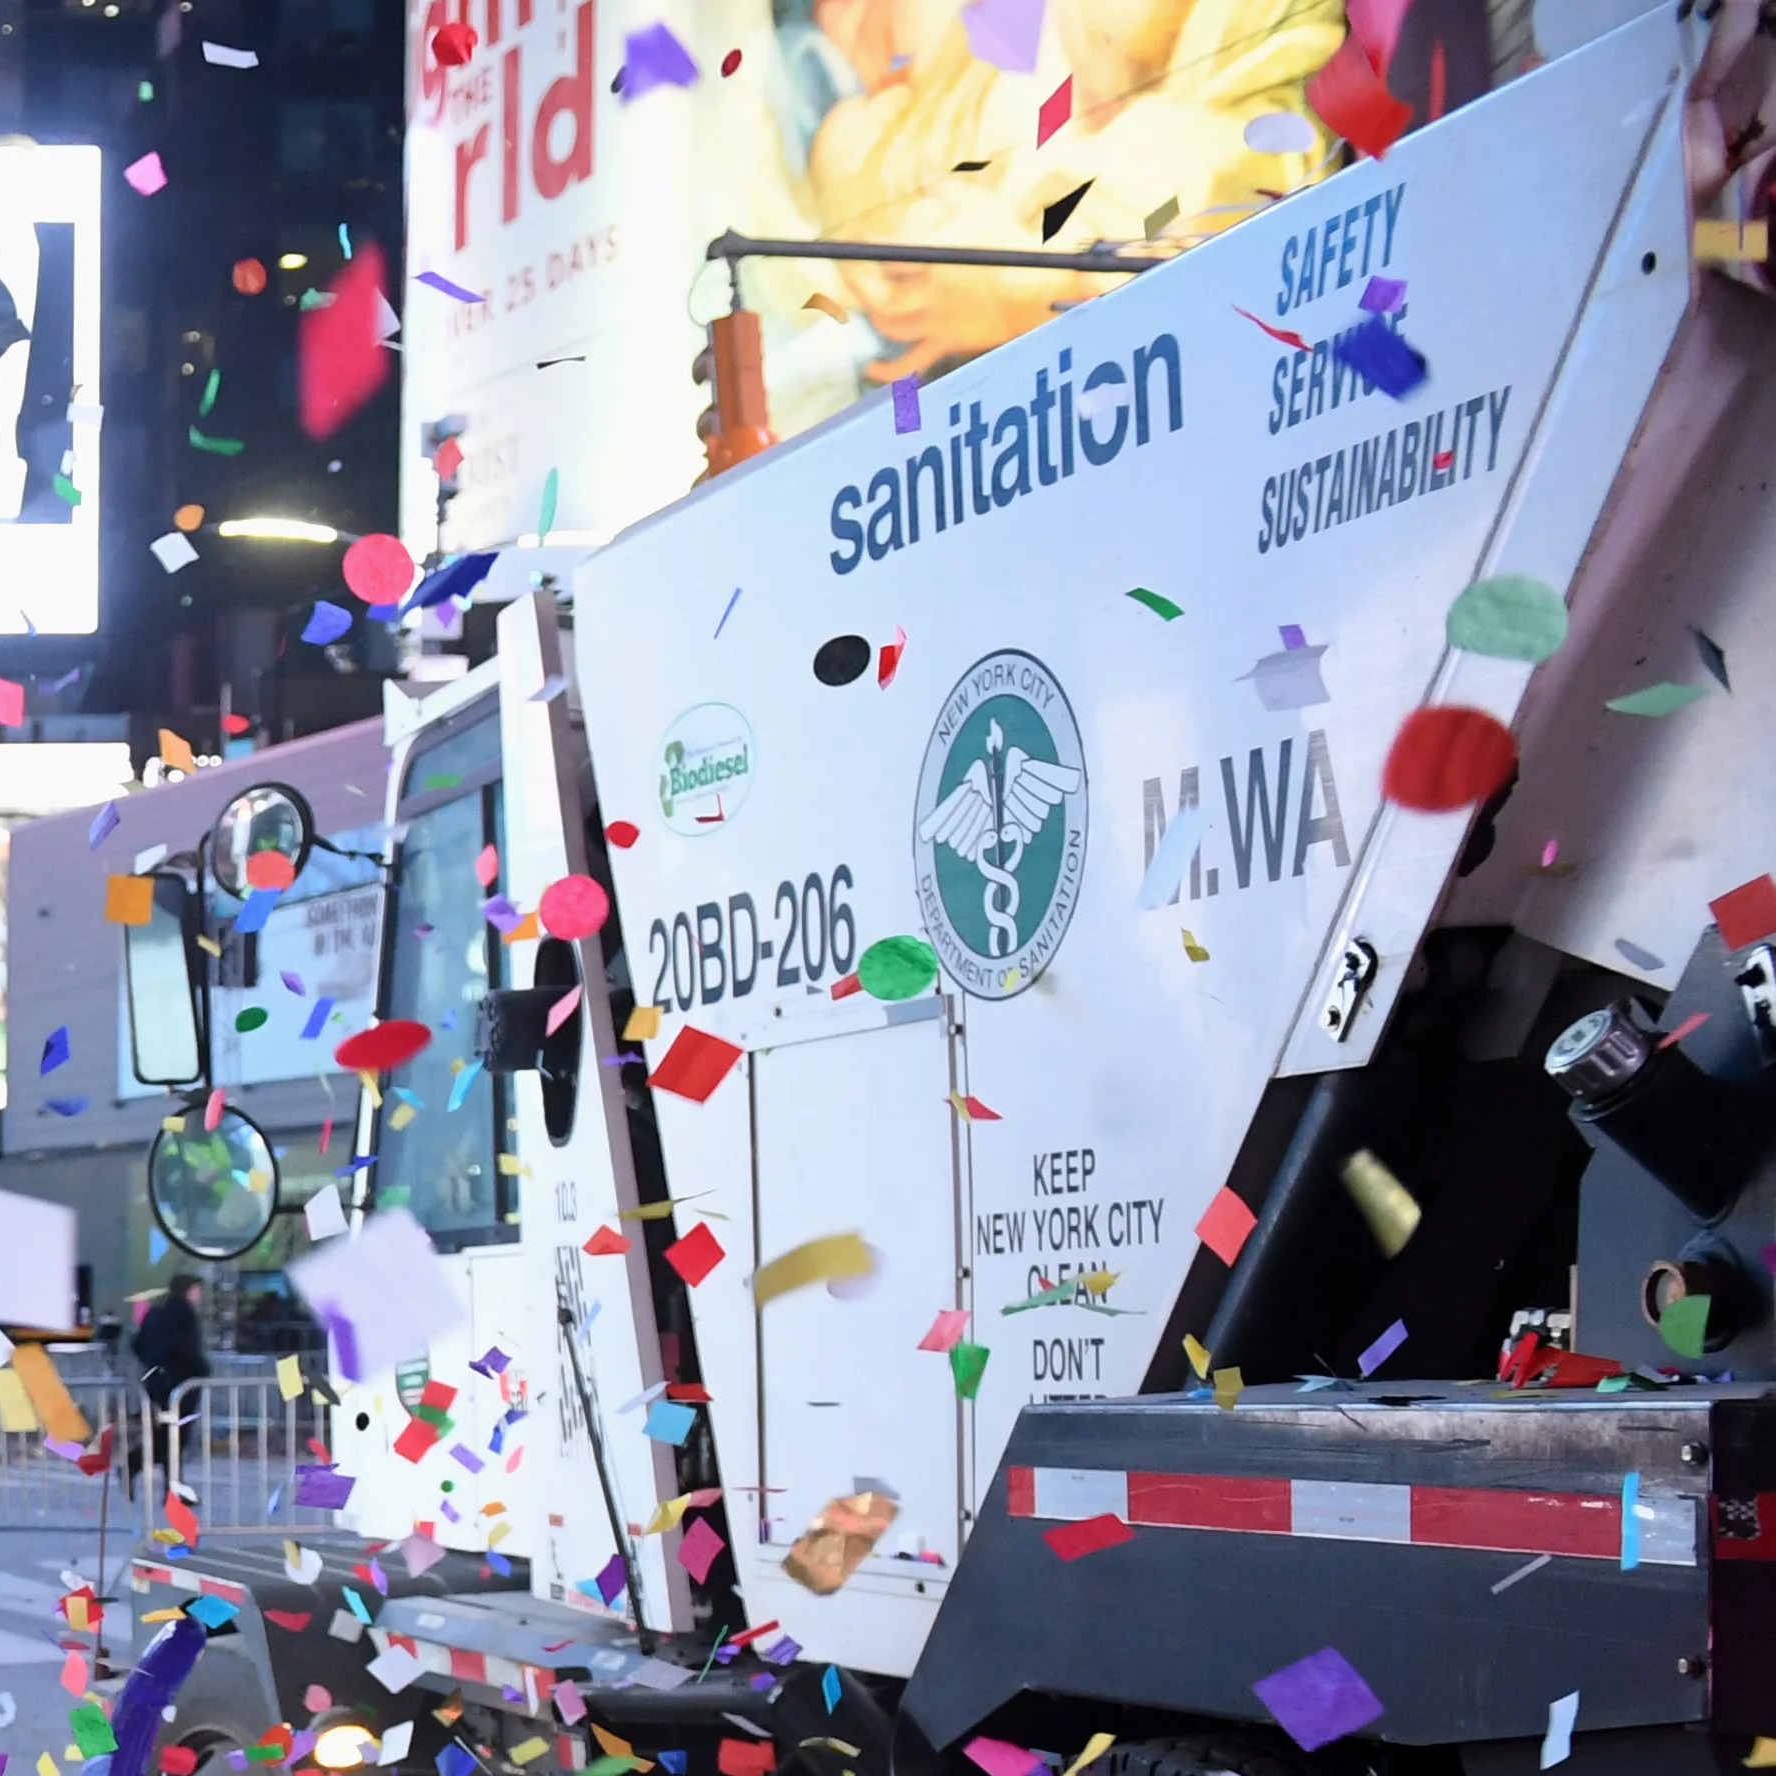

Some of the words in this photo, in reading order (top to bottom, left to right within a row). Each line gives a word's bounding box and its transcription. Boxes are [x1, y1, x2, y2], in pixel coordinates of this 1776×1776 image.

[1276, 181, 1407, 316] SAFETY
[1269, 302, 1410, 436] SERV
[830, 333, 1184, 576] sanitation
[1258, 384, 1513, 555] SUSTAINABILITY
[668, 743, 749, 797] Biodiesel
[938, 685, 971, 746] NEW
[972, 663, 1017, 699] YORK
[1019, 666, 1055, 709] CITY
[649, 863, 856, 1015] 20BD-206
[920, 874, 994, 990] DEPARTMENT
[1019, 829, 1081, 979] SANITATION
[976, 1211, 1026, 1256] NEW
[1032, 1204, 1101, 1252] YORK
[1108, 1197, 1165, 1247] CITY
[1033, 1148, 1096, 1197] KEEP
[1032, 1338, 1105, 1382] DON'T
